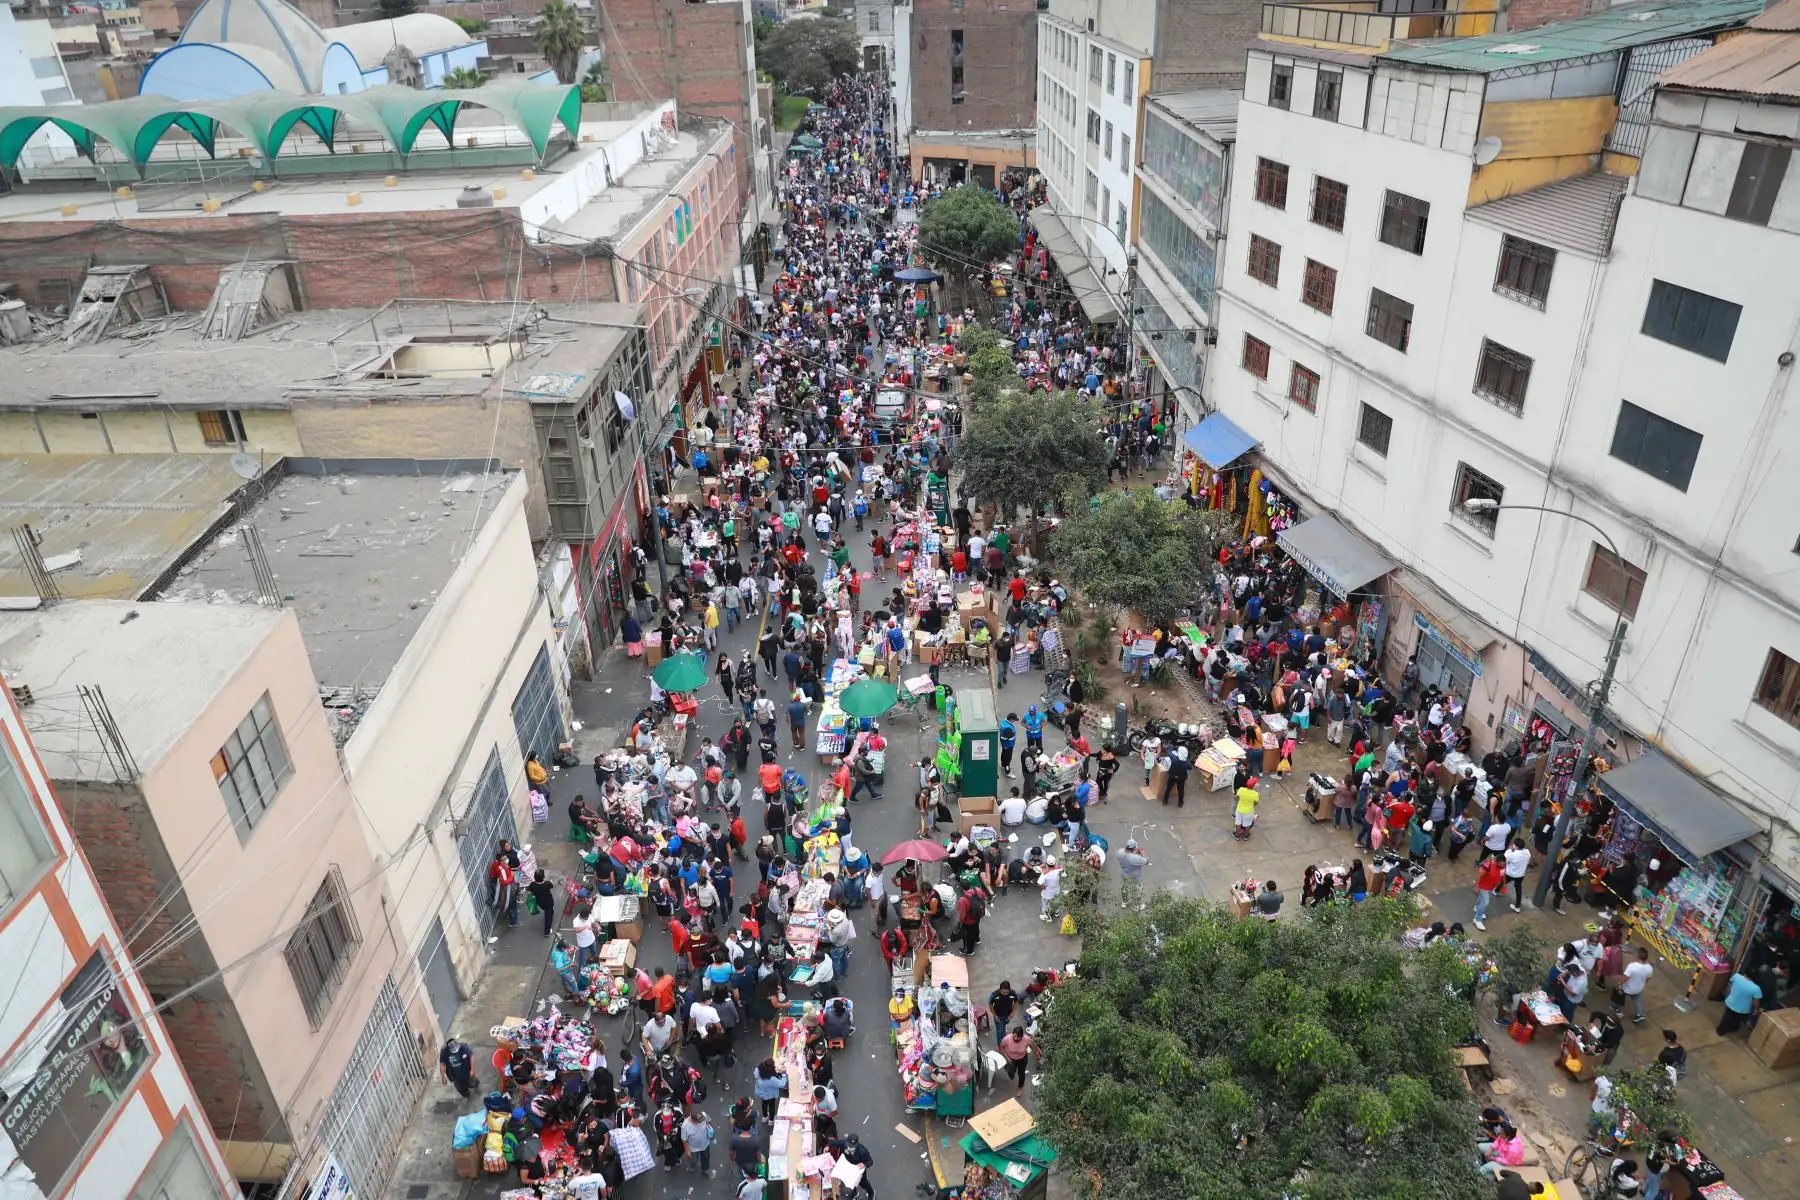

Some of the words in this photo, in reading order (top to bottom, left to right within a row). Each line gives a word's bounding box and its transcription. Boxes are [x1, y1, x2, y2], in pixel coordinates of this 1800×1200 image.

[1275, 536, 1328, 583] ANDAHUAYLAS
[5, 1068, 52, 1129] CORTES
[52, 1050, 69, 1070] EL
[15, 1100, 45, 1139] MEJOR
[19, 1115, 47, 1151] HASTA
[46, 1093, 62, 1116] LAS
[61, 1054, 91, 1095] PUNTAS
